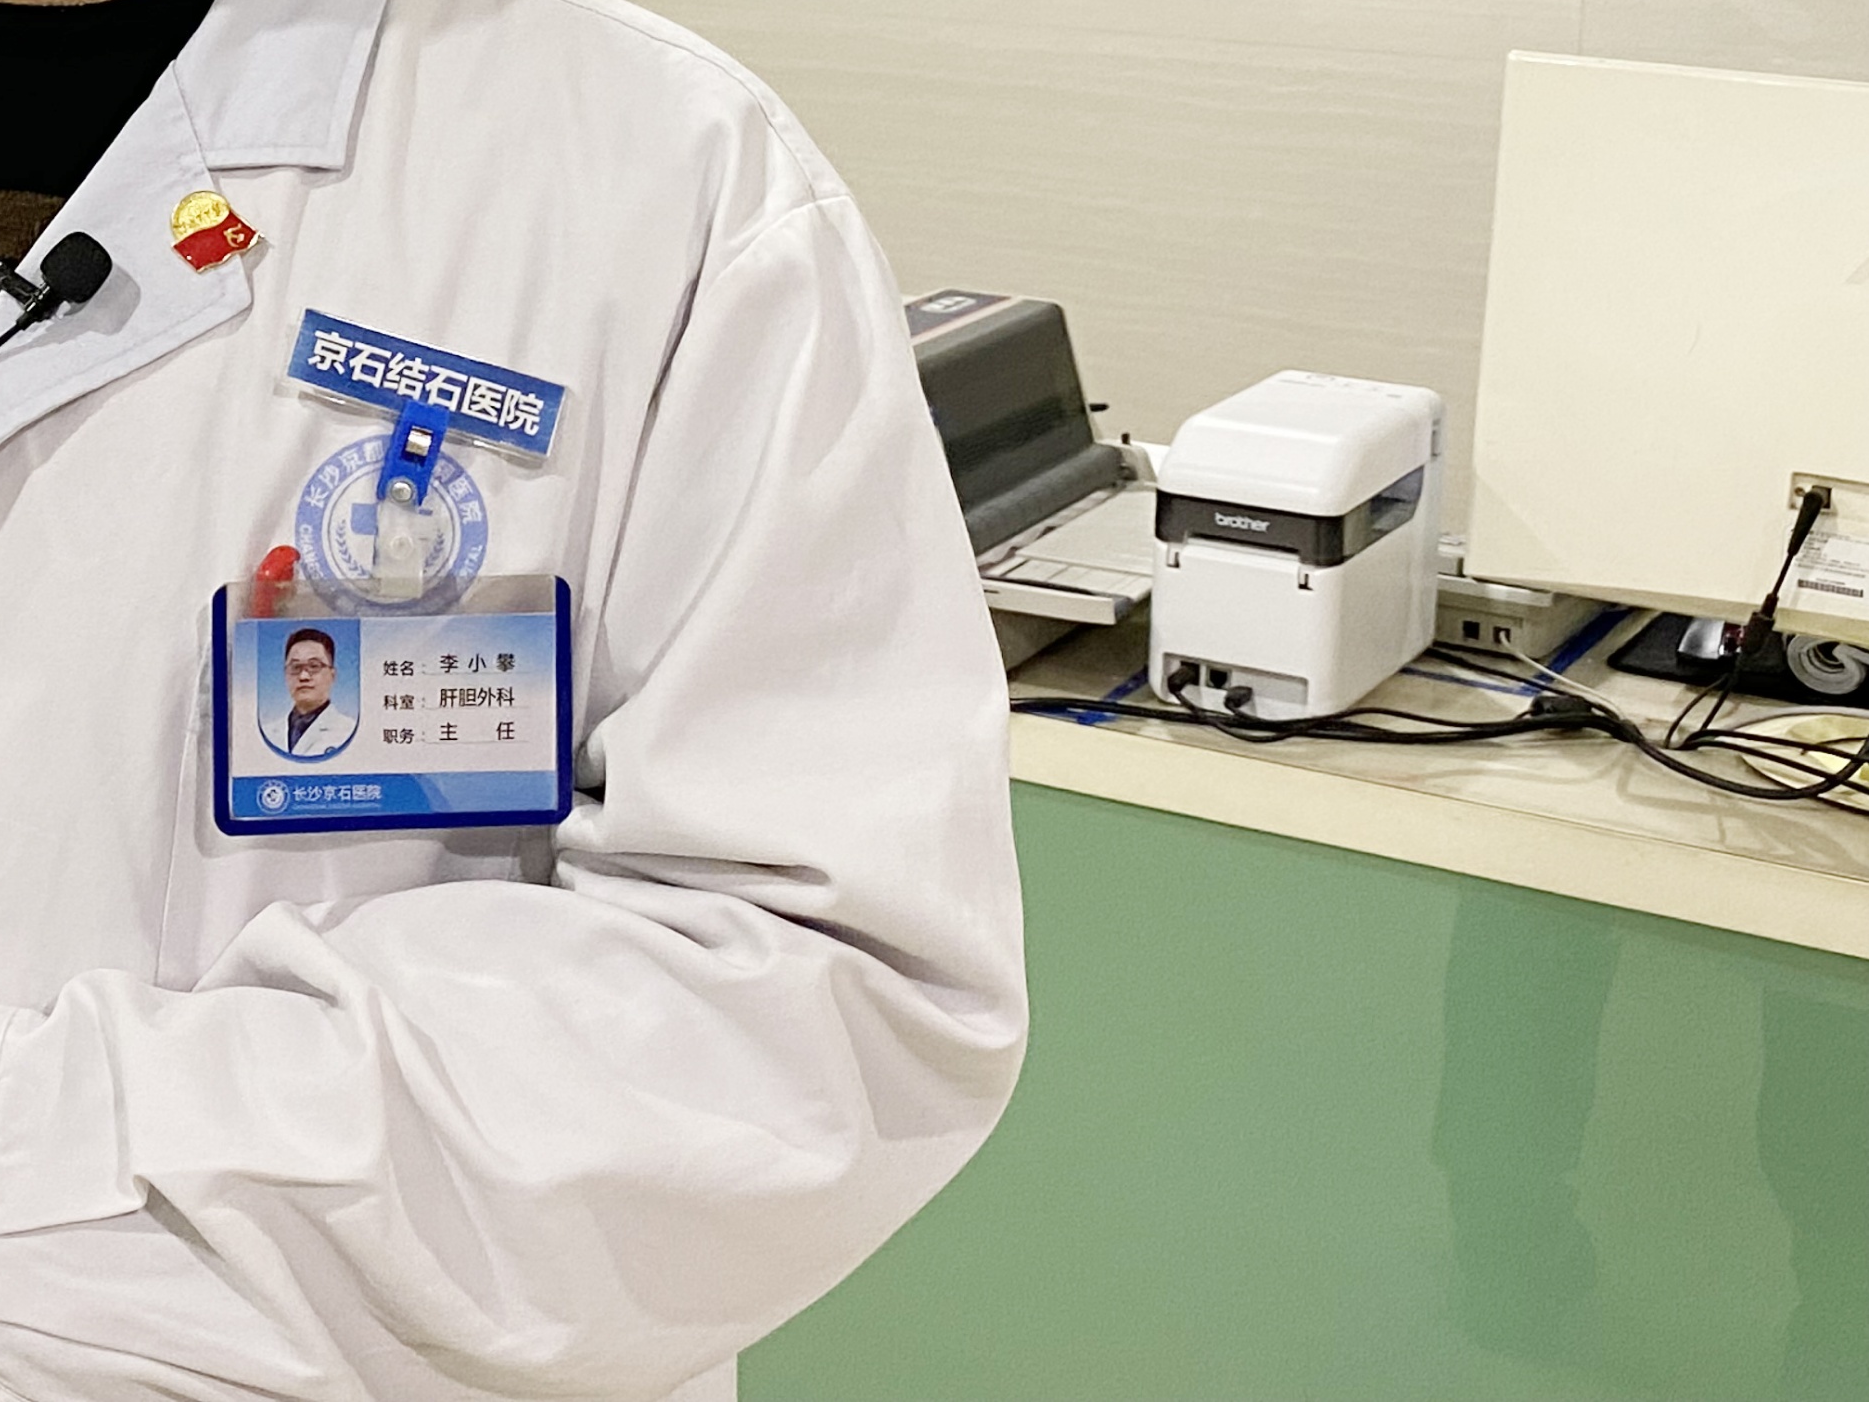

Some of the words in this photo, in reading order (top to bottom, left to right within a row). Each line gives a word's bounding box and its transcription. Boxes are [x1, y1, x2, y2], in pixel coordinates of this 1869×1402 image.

[307, 329, 544, 436] 京石结石医院
[1214, 511, 1271, 534] brother
[439, 653, 515, 673] 李小攀
[439, 687, 515, 708] 肝胆外科
[439, 721, 515, 741] 主任
[292, 784, 382, 802] 长沙京石医院
